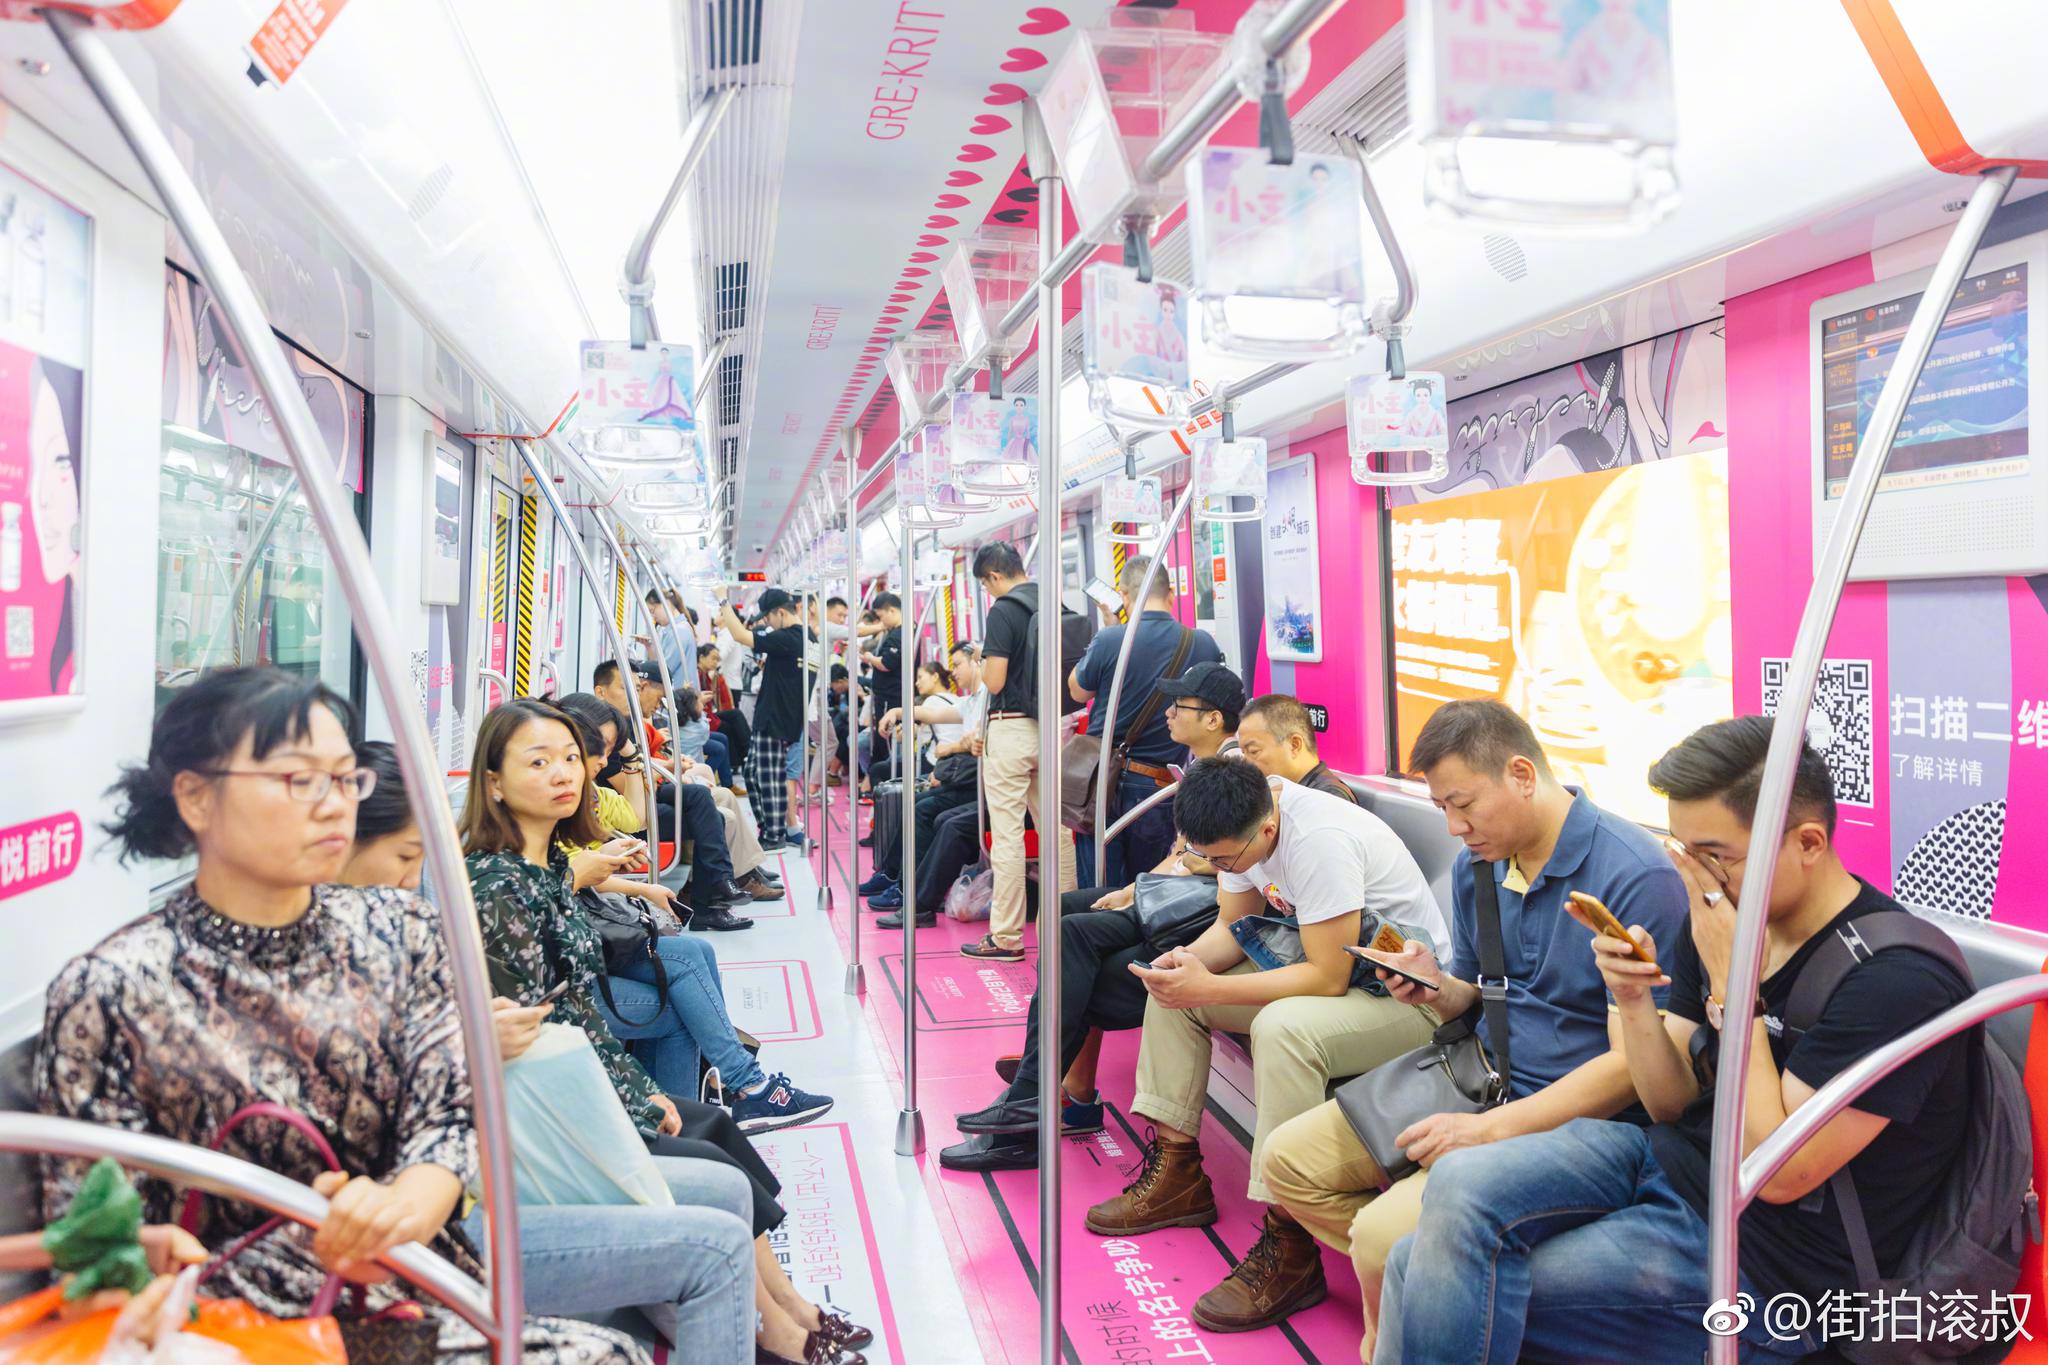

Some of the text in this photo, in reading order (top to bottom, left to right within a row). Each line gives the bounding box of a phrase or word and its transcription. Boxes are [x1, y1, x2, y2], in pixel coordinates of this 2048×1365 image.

[1101, 311, 1158, 356] 小主
[584, 377, 655, 408] 小主
[1359, 393, 1402, 414] 小主
[959, 410, 1000, 430] 小主
[1891, 693, 2048, 750] 扫描二维
[1892, 752, 1984, 787] 了解详情
[767, 1086, 792, 1107] N
